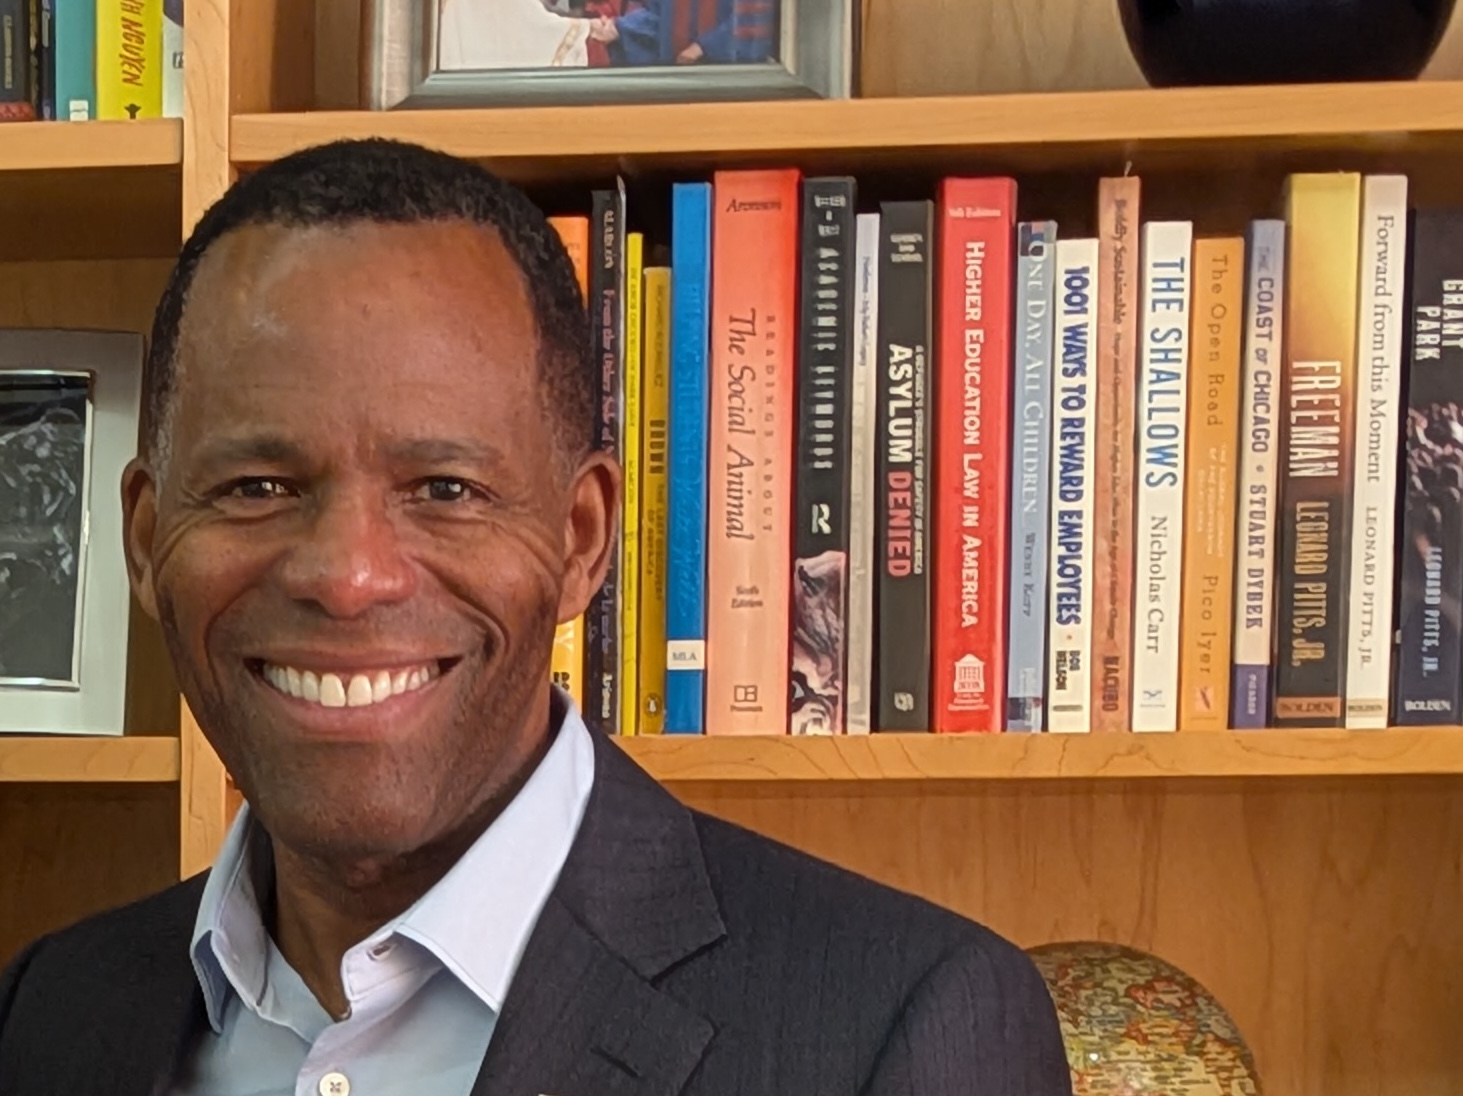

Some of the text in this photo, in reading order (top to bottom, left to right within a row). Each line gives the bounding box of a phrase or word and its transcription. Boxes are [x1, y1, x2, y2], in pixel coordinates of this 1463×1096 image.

[118, 17, 146, 87] NGUYEN
[964, 242, 985, 321] HIGHER
[1027, 241, 1048, 290] ONE
[1112, 246, 1127, 325] Sustainable
[1206, 254, 1228, 426] The Open Road
[1255, 277, 1274, 342] COAST
[1366, 214, 1394, 482] Forward from this Moment
[1415, 306, 1441, 361] PARK
[1442, 279, 1463, 350] GRANT
[963, 329, 985, 445] EDUCATION
[1023, 353, 1044, 396] ALL
[1252, 370, 1272, 454] CHICAGO
[724, 307, 758, 541] The Social Animal
[762, 315, 776, 532] READINGS ABOUT
[1022, 400, 1044, 513] CHILDREN
[1055, 266, 1090, 626] 1001 WAYS TO REWARD EMPLOYEES
[1144, 256, 1186, 654] THE SHALLOWS Nicholas Carr
[1288, 360, 1342, 477] FREEMAN
[887, 343, 912, 577] ASYLUM DENIED
[963, 453, 983, 499] LAW
[1247, 484, 1267, 559] STUART
[961, 534, 982, 628] AMERICA
[1245, 568, 1265, 630] DYBEK
[1292, 501, 1329, 666] LEONARD PITTS, JR.
[1357, 506, 1377, 669] LEONARD PITTS, JR.
[1420, 547, 1442, 678] LEONARD PITTS, JR.
[672, 651, 696, 661] MLA
[1069, 650, 1081, 671] BOB
[1196, 574, 1218, 674] Pico Iyer
[1055, 650, 1067, 690] NELSON
[1102, 655, 1120, 712] NACUBO
[1404, 699, 1452, 712] BOLDEN
